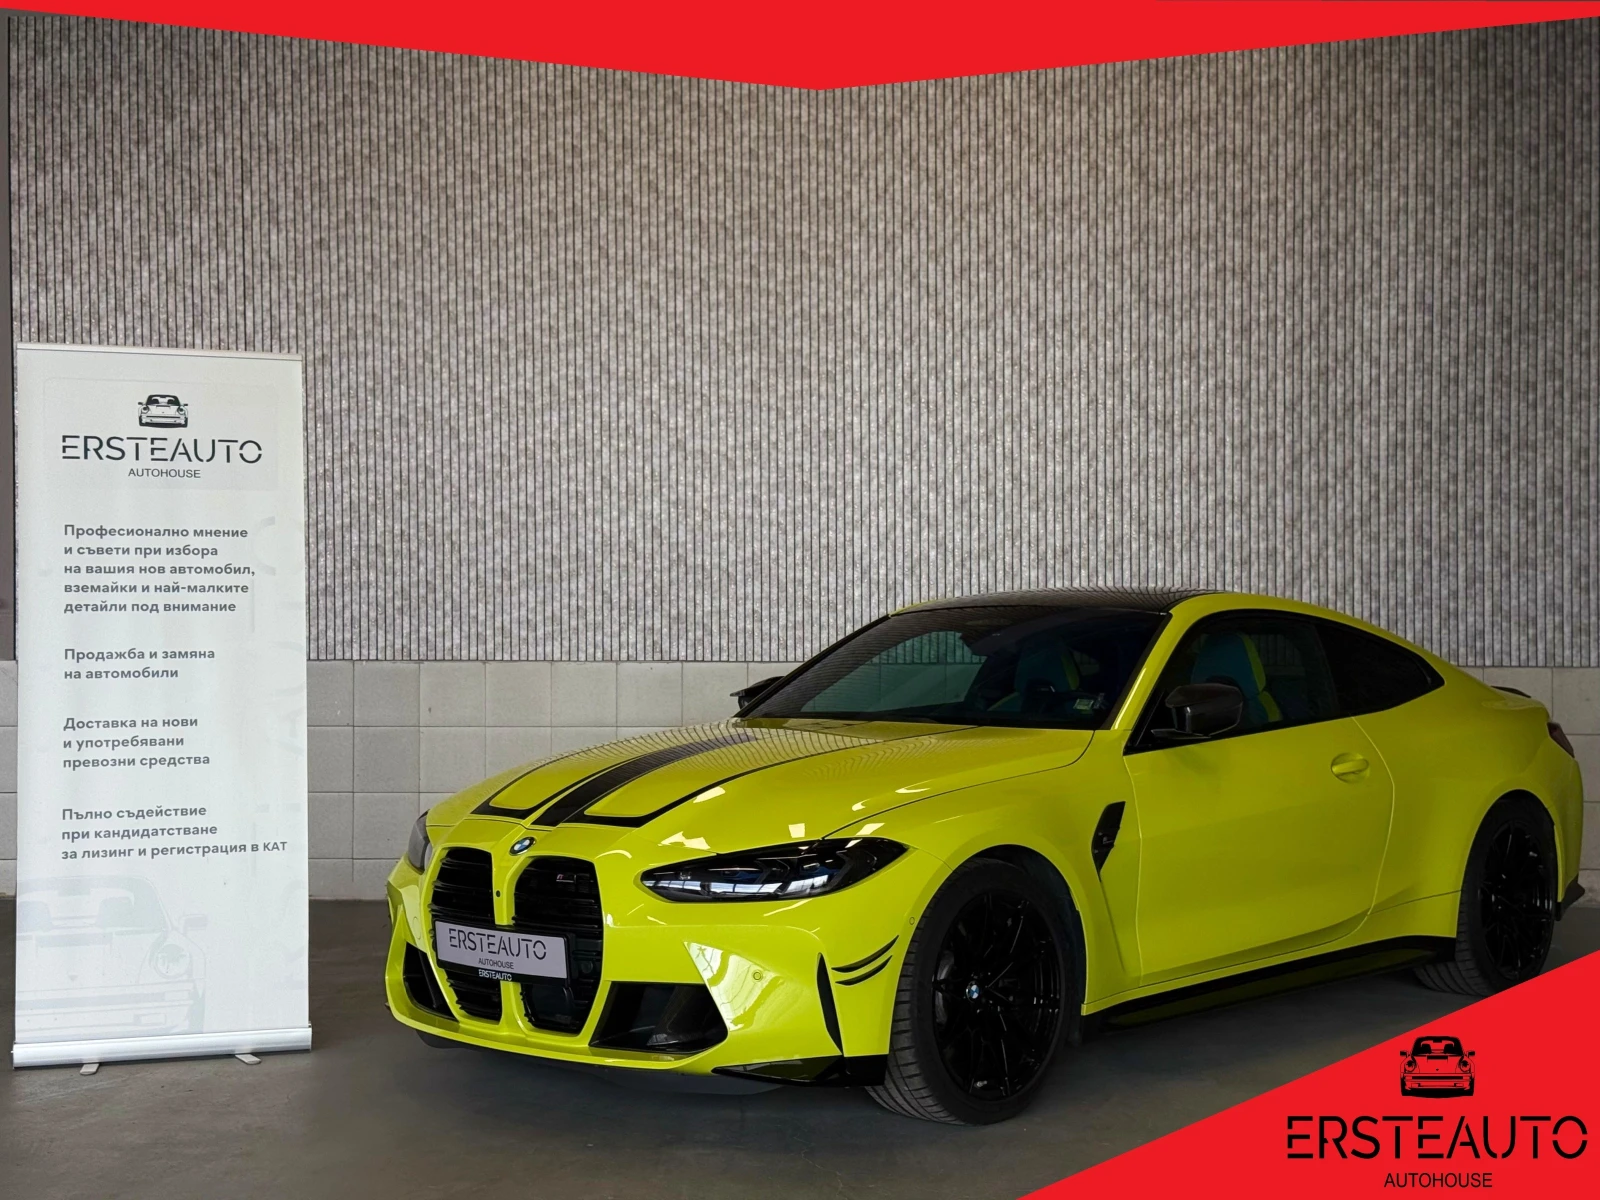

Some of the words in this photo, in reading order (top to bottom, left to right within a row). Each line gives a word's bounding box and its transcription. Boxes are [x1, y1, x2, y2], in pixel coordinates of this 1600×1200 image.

[61, 434, 263, 464] ERSTEAUTO
[127, 467, 201, 479] AUTOHOUSE
[64, 524, 190, 540] Професионално
[193, 528, 249, 538] мнение
[63, 546, 73, 555] и
[76, 546, 131, 556] съвети
[134, 546, 162, 559] при
[165, 543, 219, 560] избора
[63, 565, 82, 574] на
[85, 565, 135, 574] вашия
[138, 565, 166, 575] нов
[169, 562, 256, 577] автомобил,
[63, 580, 138, 594] вземайки
[141, 584, 150, 593] и
[154, 580, 249, 594] най-малките
[63, 600, 127, 615] детайли
[131, 603, 160, 614] под
[163, 603, 237, 612] внимание
[64, 647, 145, 664] Продажба
[149, 650, 158, 660] и
[161, 650, 215, 660] замяна
[64, 670, 82, 680] на
[85, 666, 179, 680] автомобили
[62, 717, 137, 732] Доставка
[140, 718, 158, 728] на
[162, 718, 198, 728] нови
[63, 740, 72, 749] и
[75, 734, 185, 753] употребявани
[63, 757, 136, 772] превозни
[139, 755, 210, 770] средства
[62, 808, 113, 821] Пълно
[116, 805, 207, 821] съдействие
[61, 830, 90, 844] при
[94, 825, 218, 841] кандидатстване
[61, 850, 78, 860] за
[81, 848, 135, 859] лизинг
[137, 847, 147, 857] и
[150, 843, 247, 860] регистрация
[250, 843, 260, 853] в
[262, 841, 288, 852] КАТ
[448, 928, 547, 960] ERSTEAUTO
[478, 958, 514, 969] AUTOHOUSE
[478, 969, 512, 981] ERSTEAUTO
